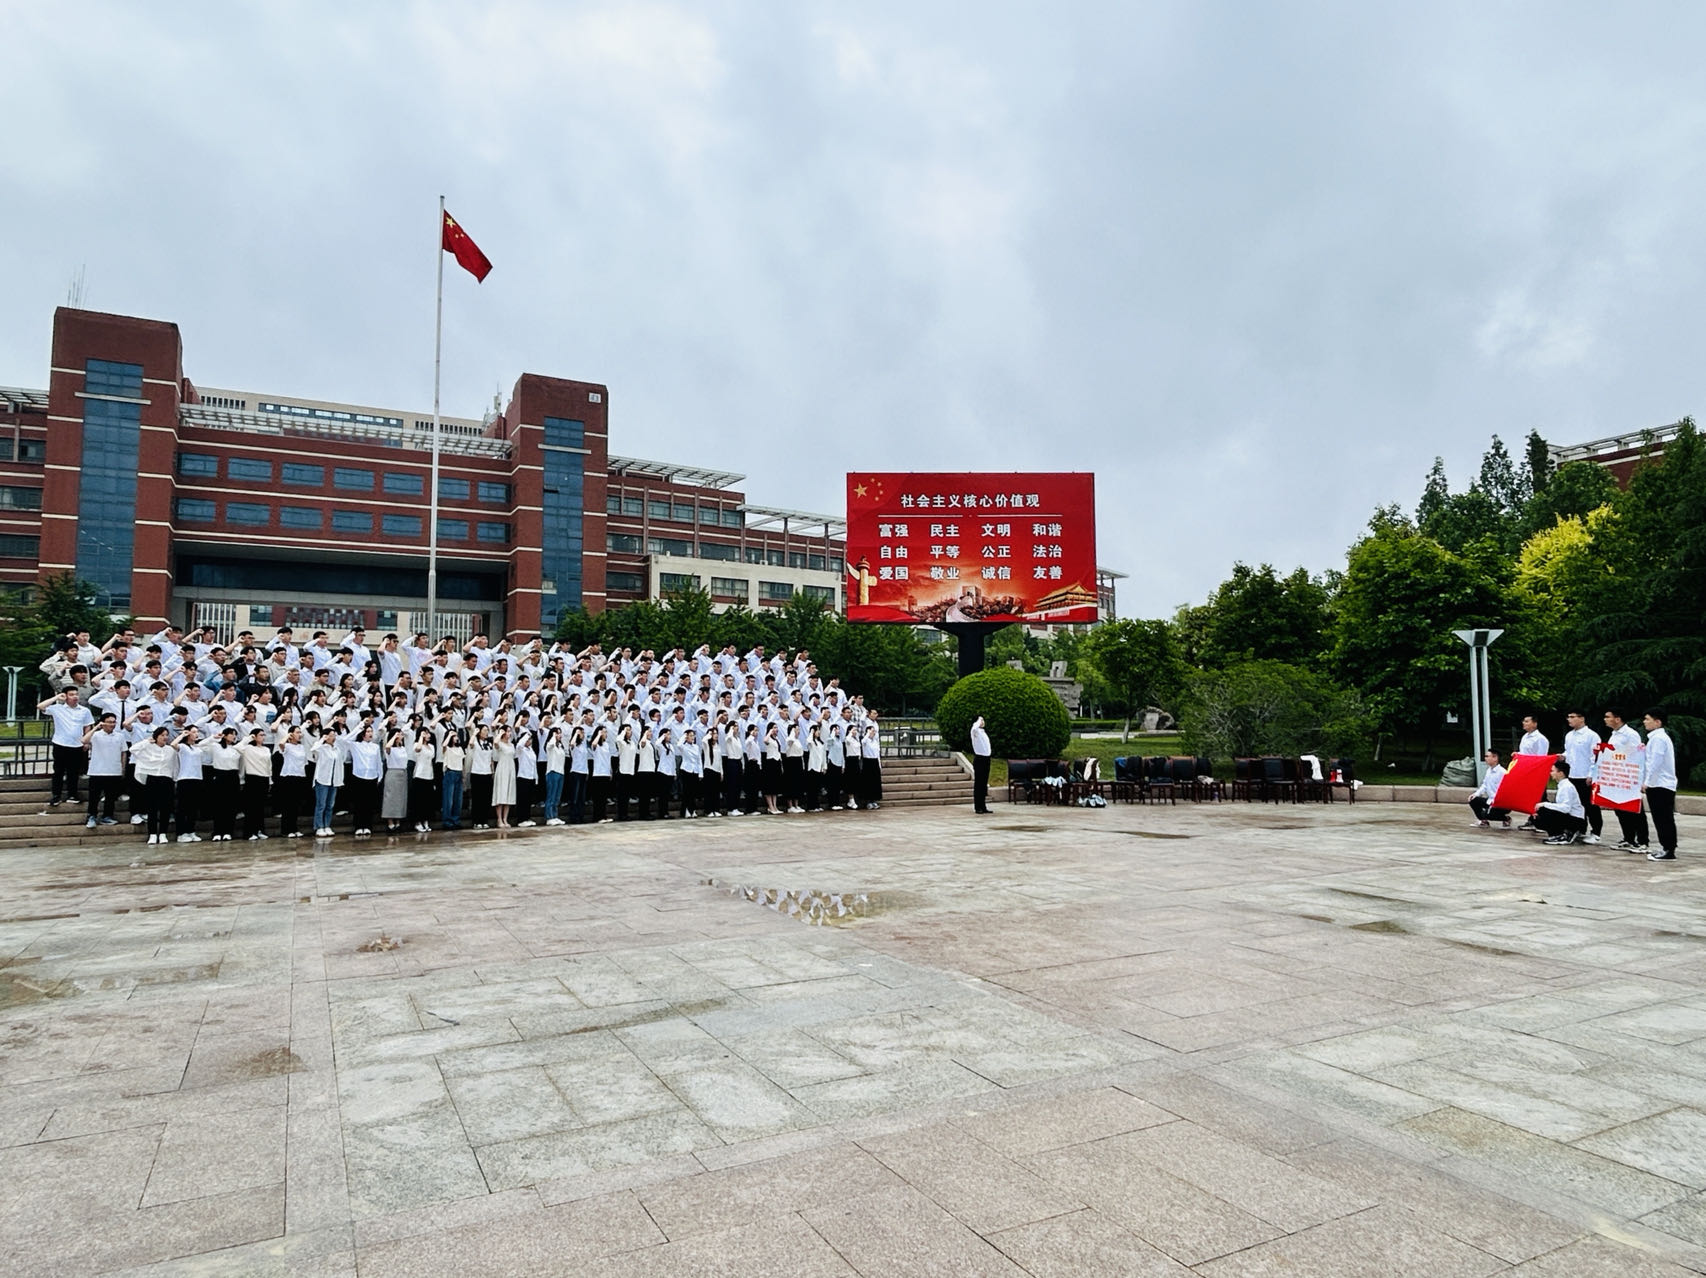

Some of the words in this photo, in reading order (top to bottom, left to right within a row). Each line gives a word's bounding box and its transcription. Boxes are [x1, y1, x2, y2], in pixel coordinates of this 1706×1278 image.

[900, 494, 1040, 508] 社会主义核心价值观
[878, 523, 909, 538] 富强
[930, 523, 960, 538] 民主
[981, 523, 1011, 537] 文明
[1032, 523, 1063, 537] 和谐
[880, 545, 908, 559] 自由
[929, 545, 960, 559] 平等
[981, 545, 1011, 558] 公正
[1032, 544, 1063, 558] 法治
[879, 566, 909, 581] 爱国
[930, 566, 961, 580] 敬业
[981, 565, 1012, 580] 诚信
[1033, 565, 1063, 580] 友善
